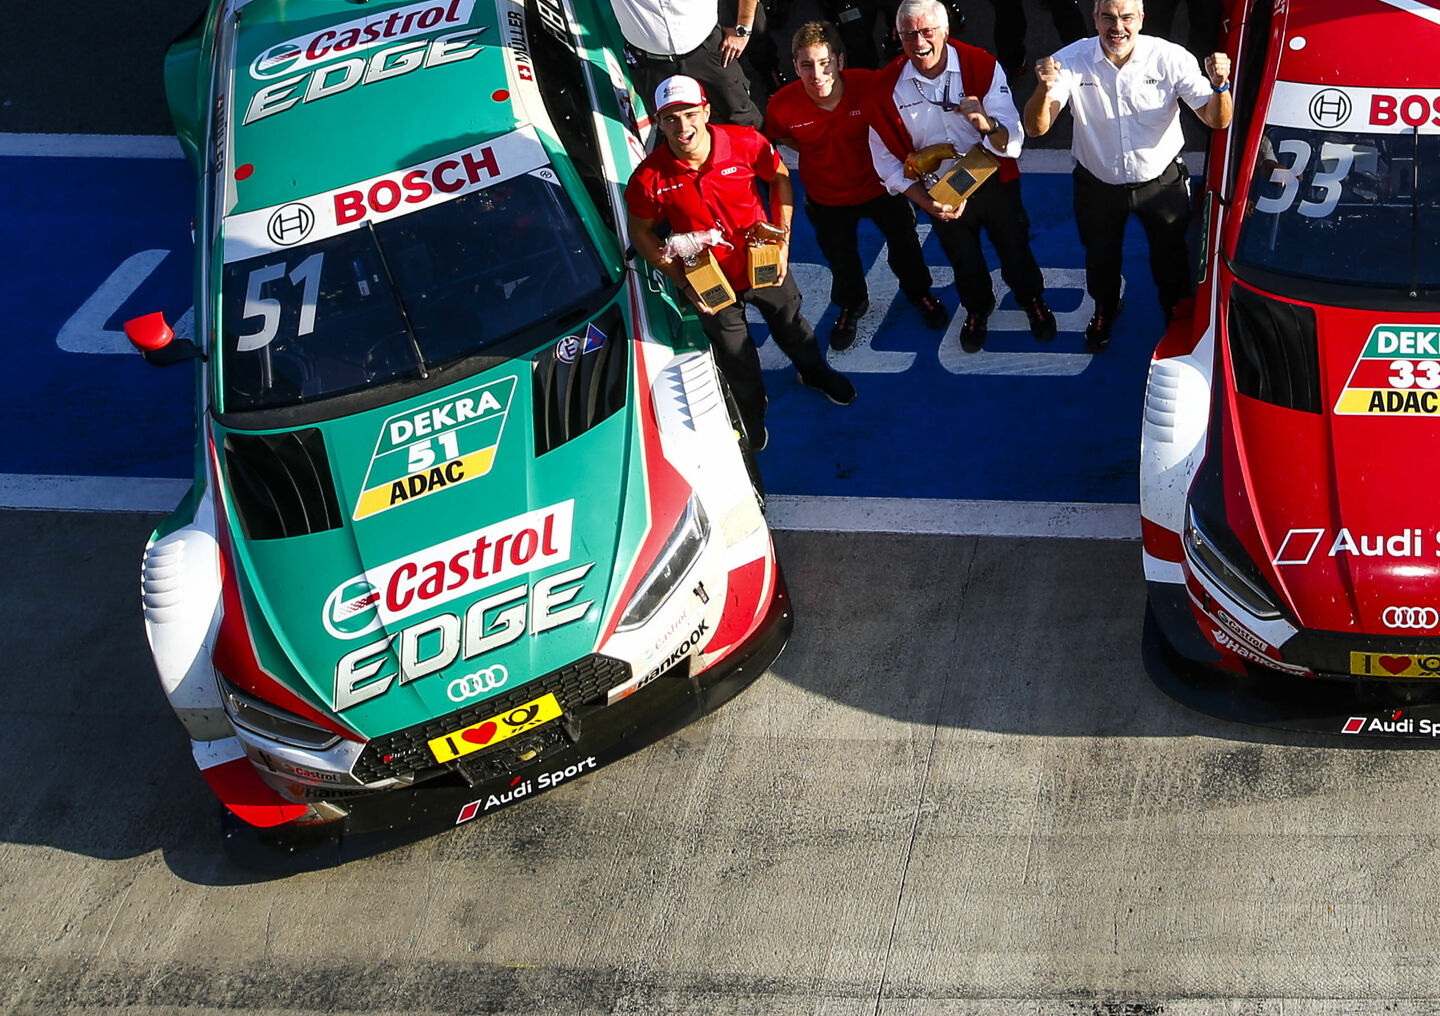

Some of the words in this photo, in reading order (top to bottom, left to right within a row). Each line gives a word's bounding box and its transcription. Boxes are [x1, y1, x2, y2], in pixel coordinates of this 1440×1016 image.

[508, 11, 530, 64] MÜLLER
[243, 26, 490, 126] EDGE
[334, 146, 501, 226] BOSCH
[1255, 139, 1354, 218] 33
[236, 251, 325, 352] 51
[390, 390, 502, 445] DEKRA
[1368, 391, 1438, 413] ADAC
[408, 431, 460, 473] 51
[390, 460, 465, 505] ADAC
[384, 512, 560, 614] Castrol
[1329, 527, 1423, 558] Audi
[333, 562, 598, 712] EDGE
[1368, 717, 1413, 733] Audi
[295, 767, 338, 782] Castrol
[484, 780, 532, 810] Audi
[538, 756, 597, 790] Sport
